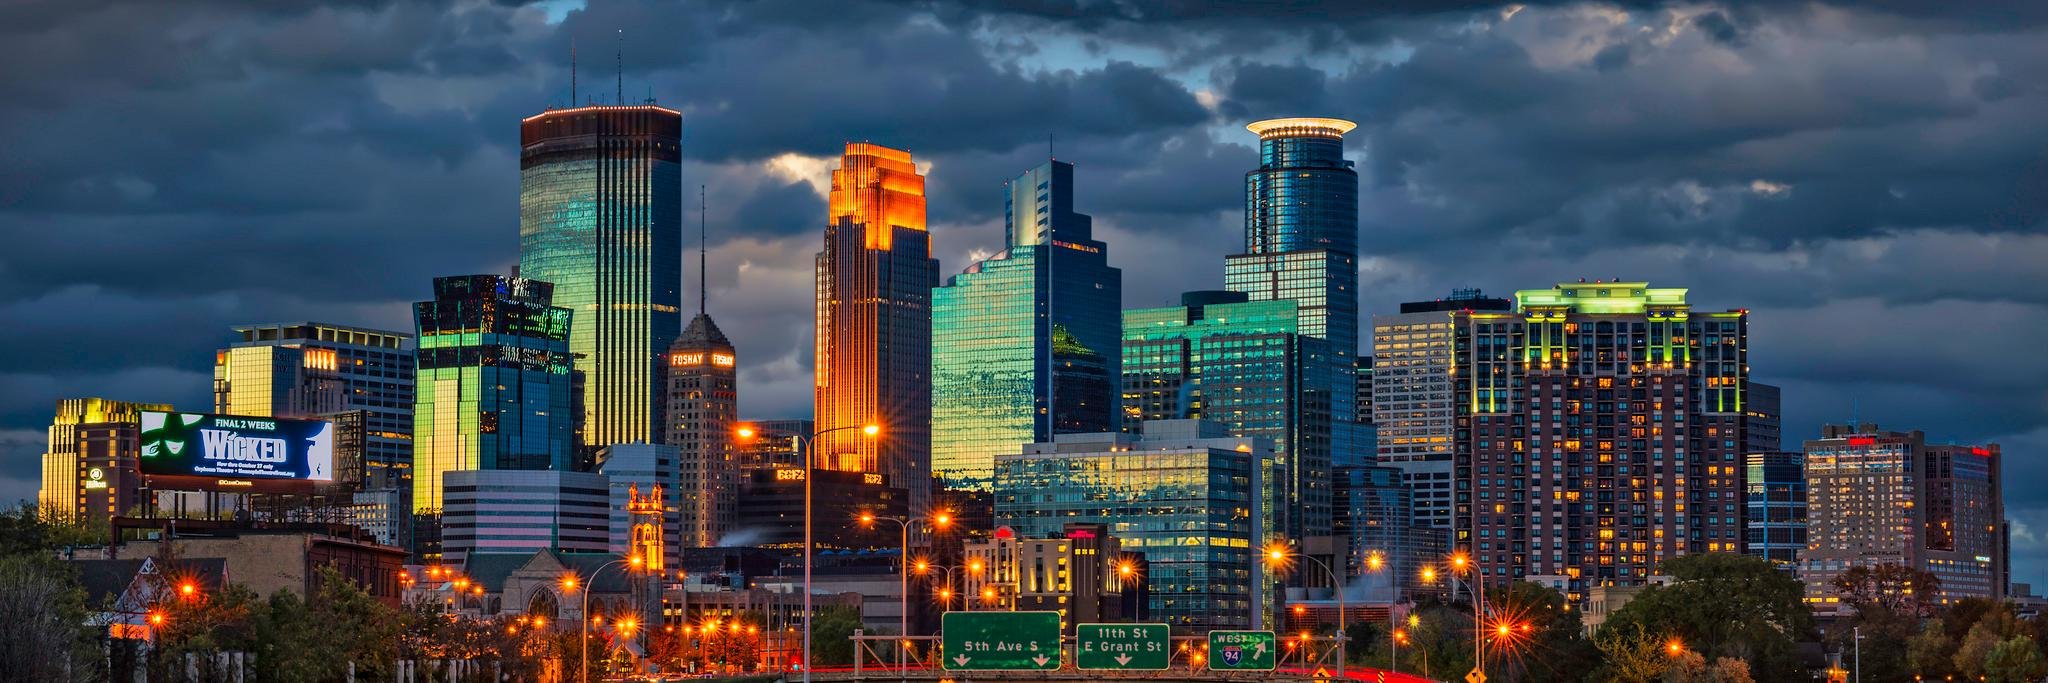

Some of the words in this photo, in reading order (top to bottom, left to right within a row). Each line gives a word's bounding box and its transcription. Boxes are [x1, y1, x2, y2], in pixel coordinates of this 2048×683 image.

[673, 353, 703, 365] FOSHAY
[215, 418, 240, 428] FINAL
[240, 420, 246, 429] 2
[247, 420, 275, 430] WEEKS
[86, 480, 107, 489] Hilton
[1098, 628, 1126, 638] 11th
[1133, 628, 1148, 638] St
[1217, 634, 1247, 643] WEST
[964, 640, 990, 651] 5th
[996, 640, 1022, 651] Ave
[1030, 640, 1038, 651] S
[1084, 641, 1093, 652] E
[1100, 641, 1139, 652] Grant
[1147, 641, 1161, 652] St
[1225, 651, 1239, 661] 94
